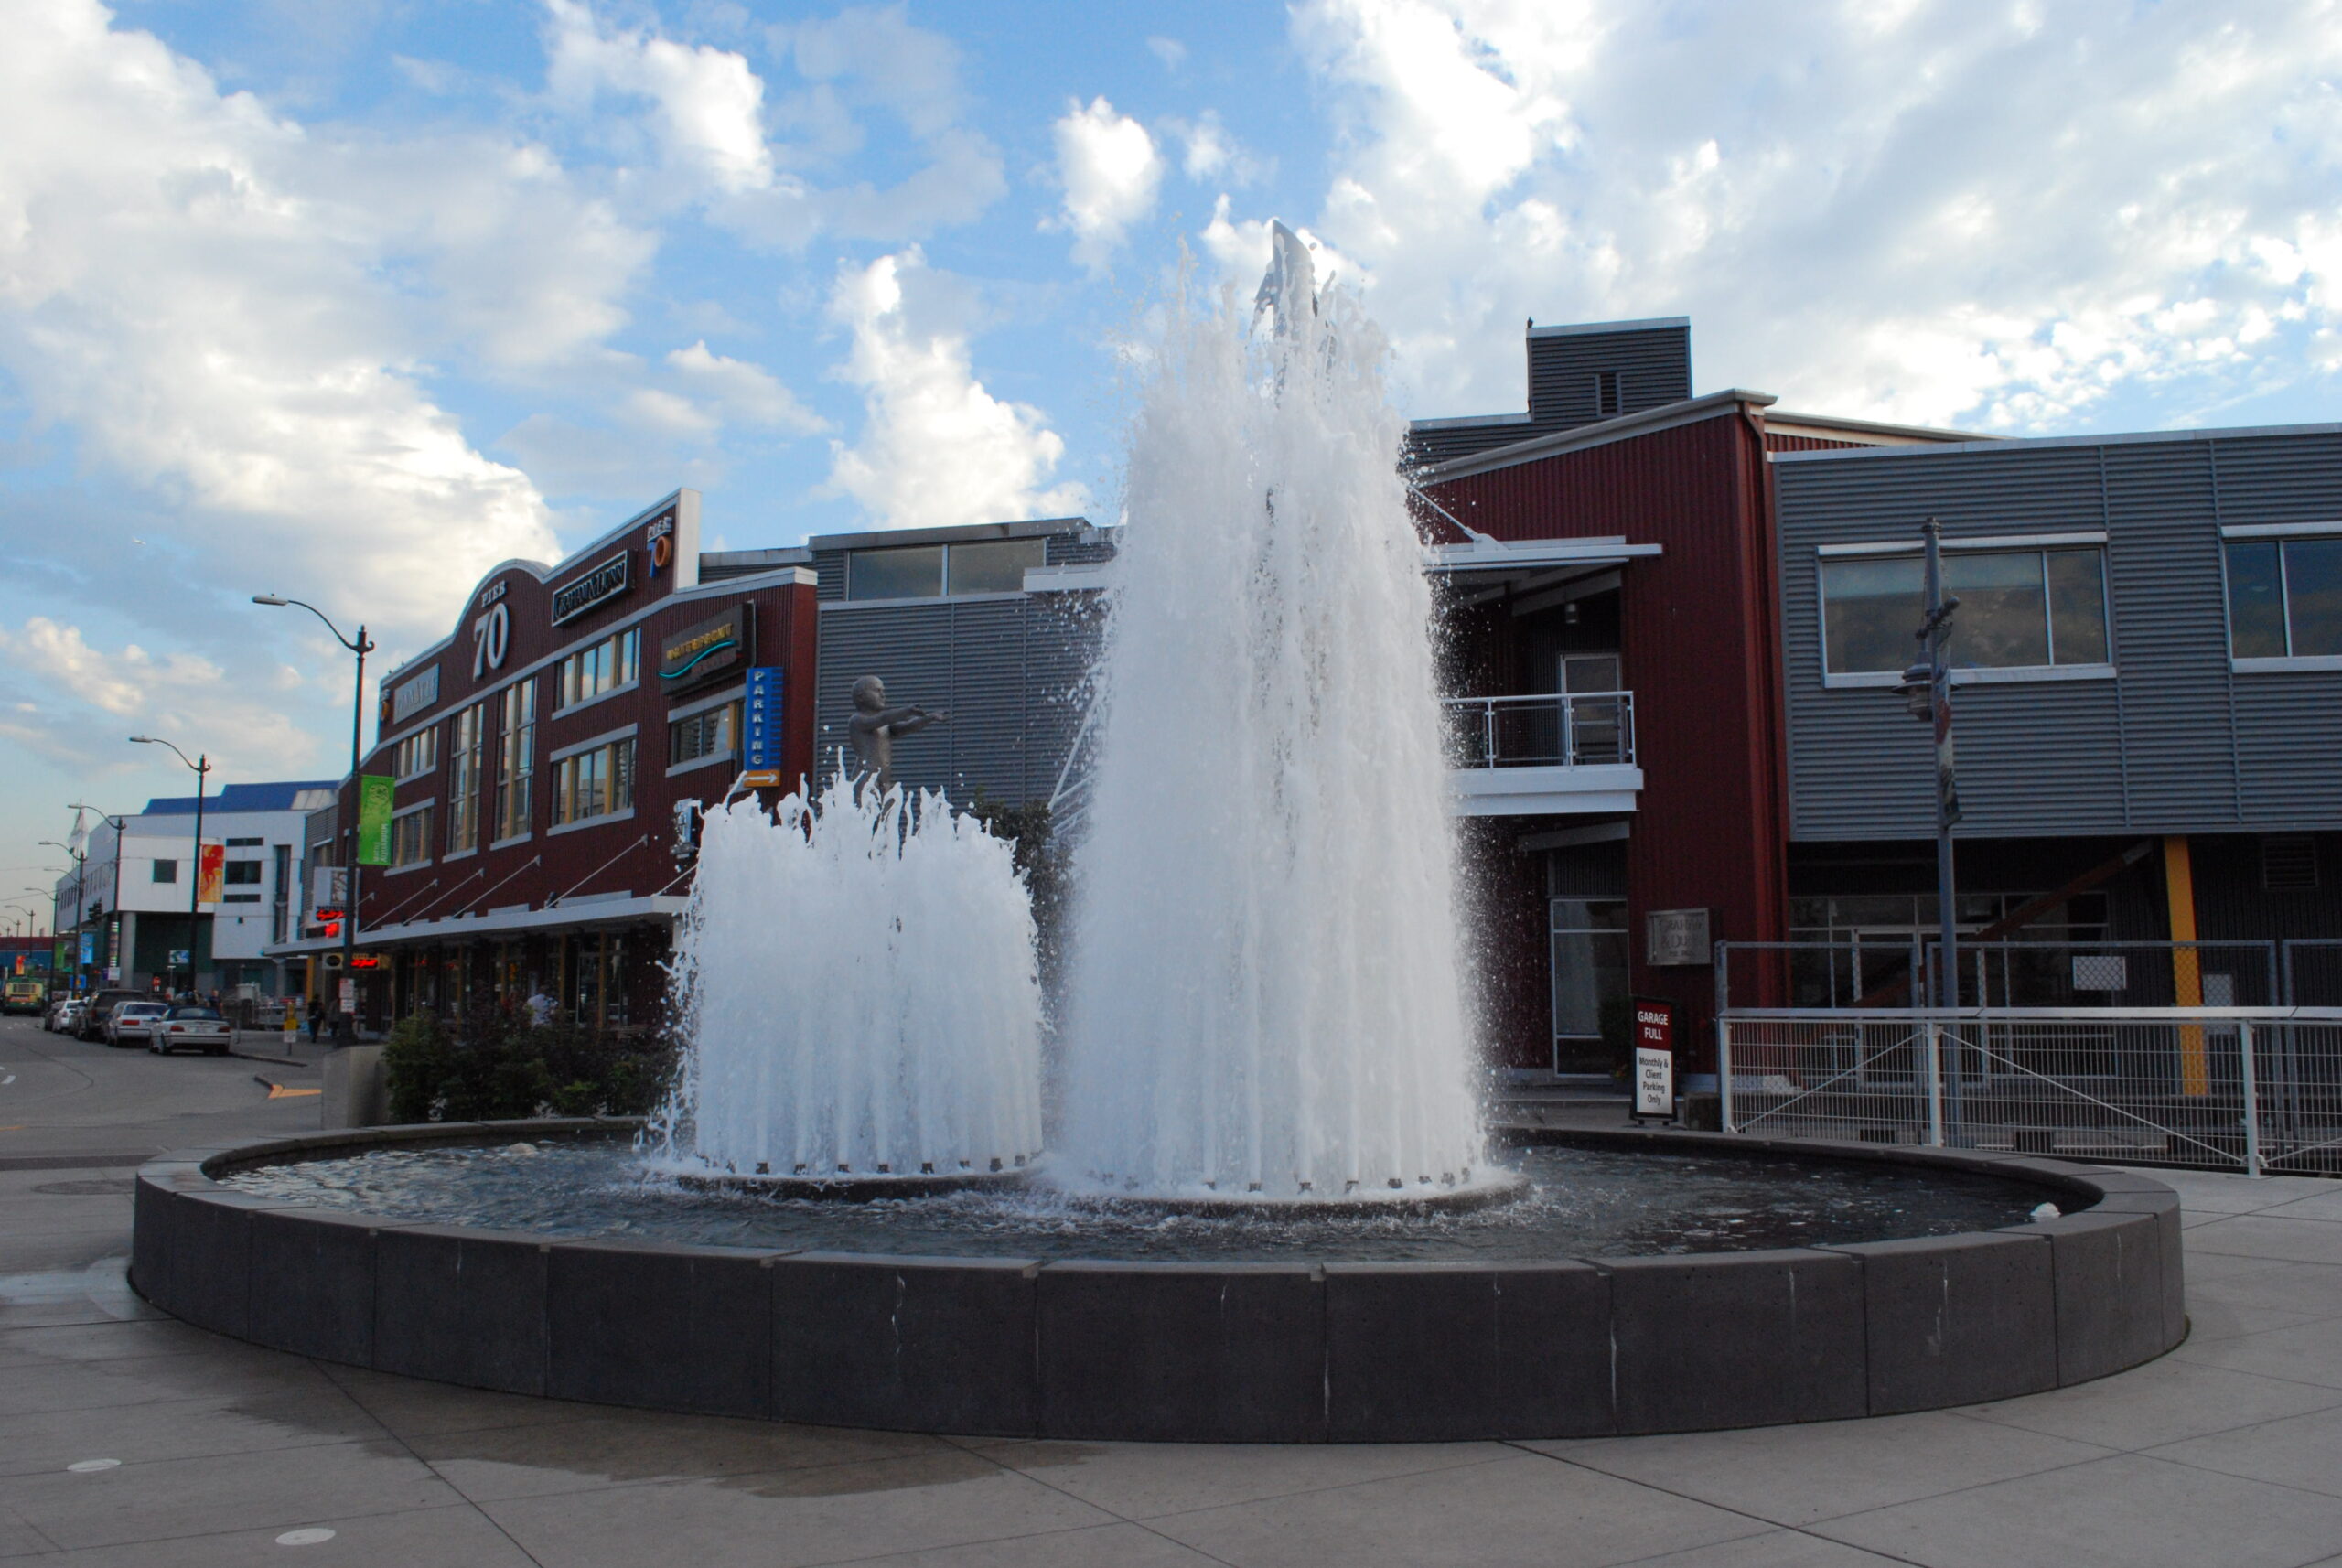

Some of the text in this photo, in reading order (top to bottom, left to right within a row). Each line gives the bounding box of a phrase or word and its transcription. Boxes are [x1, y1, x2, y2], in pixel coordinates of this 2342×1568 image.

[647, 516, 673, 542] PIER
[646, 535, 671, 578] 70
[481, 580, 507, 608] PIER
[473, 603, 510, 682] 70
[751, 671, 765, 766] PARKING
[1638, 1011, 1669, 1026] GARAGE
[1644, 1027, 1663, 1040] FULL
[1638, 1056, 1663, 1069] Monthly
[1645, 1069, 1662, 1079] Client
[1642, 1081, 1665, 1094] Parking
[1647, 1094, 1661, 1105] Only
